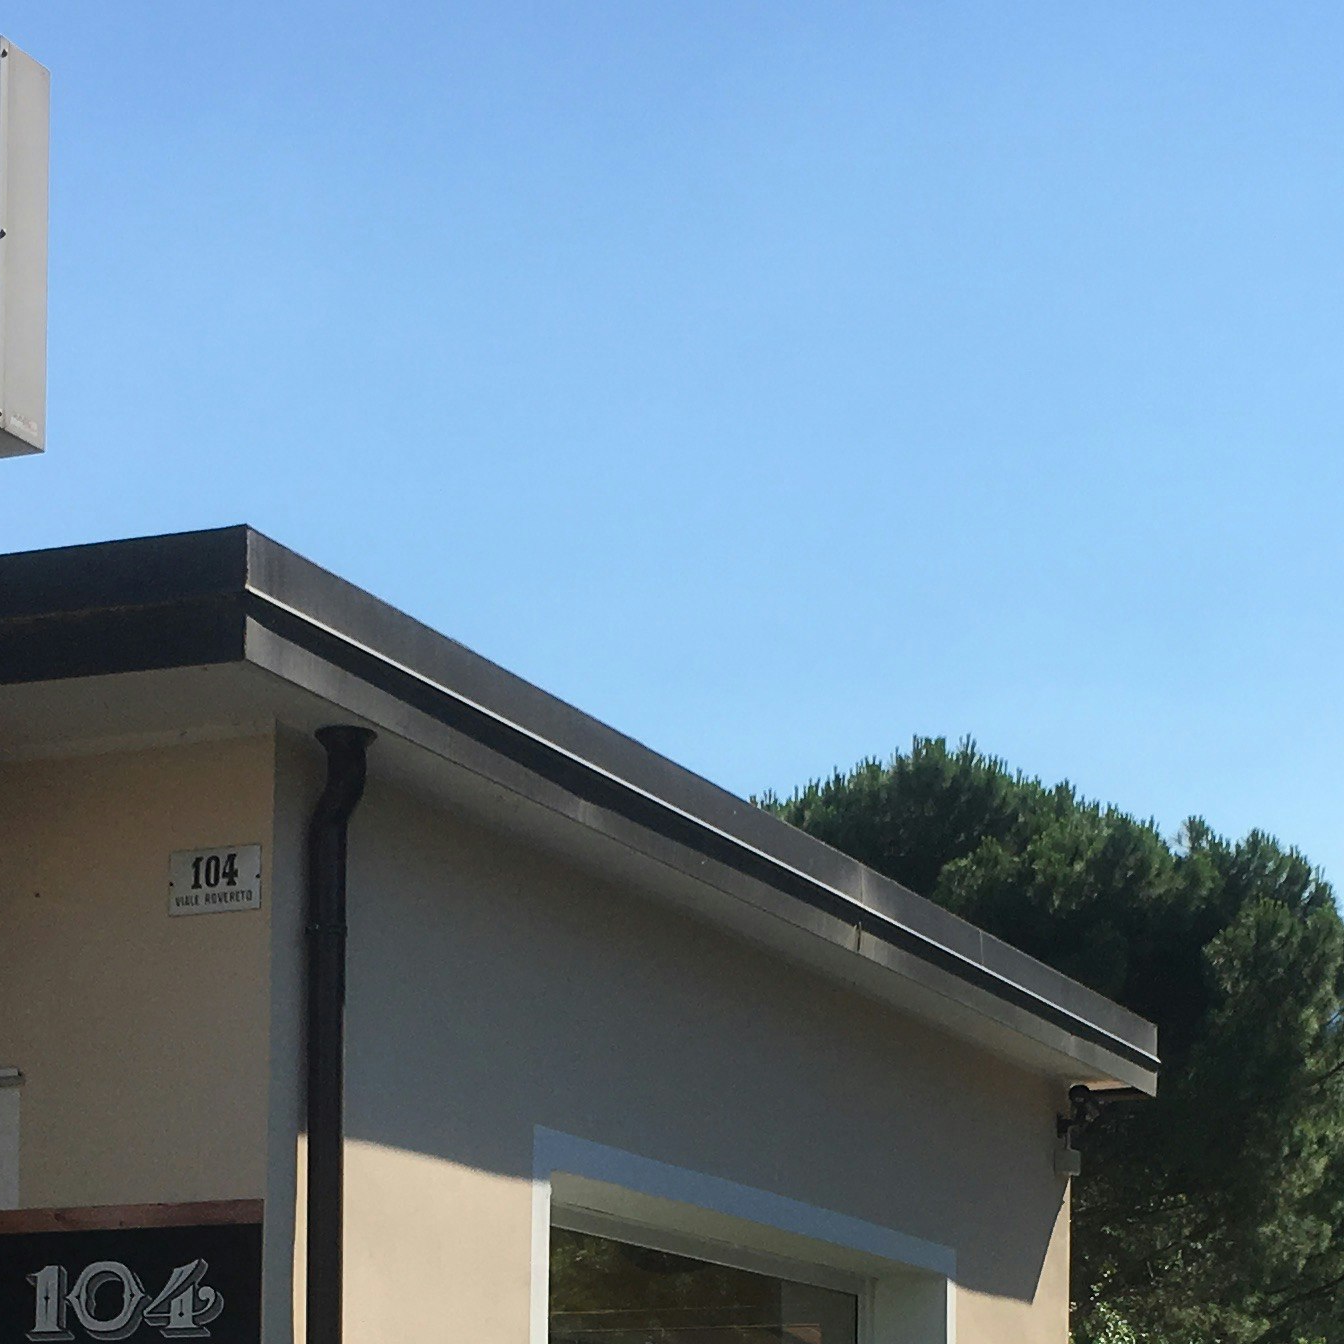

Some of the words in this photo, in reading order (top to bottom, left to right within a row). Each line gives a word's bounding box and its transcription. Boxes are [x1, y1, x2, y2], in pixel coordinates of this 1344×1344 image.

[191, 853, 239, 889] 104
[204, 890, 253, 905] ROVERETO
[25, 1258, 225, 1342] 104
